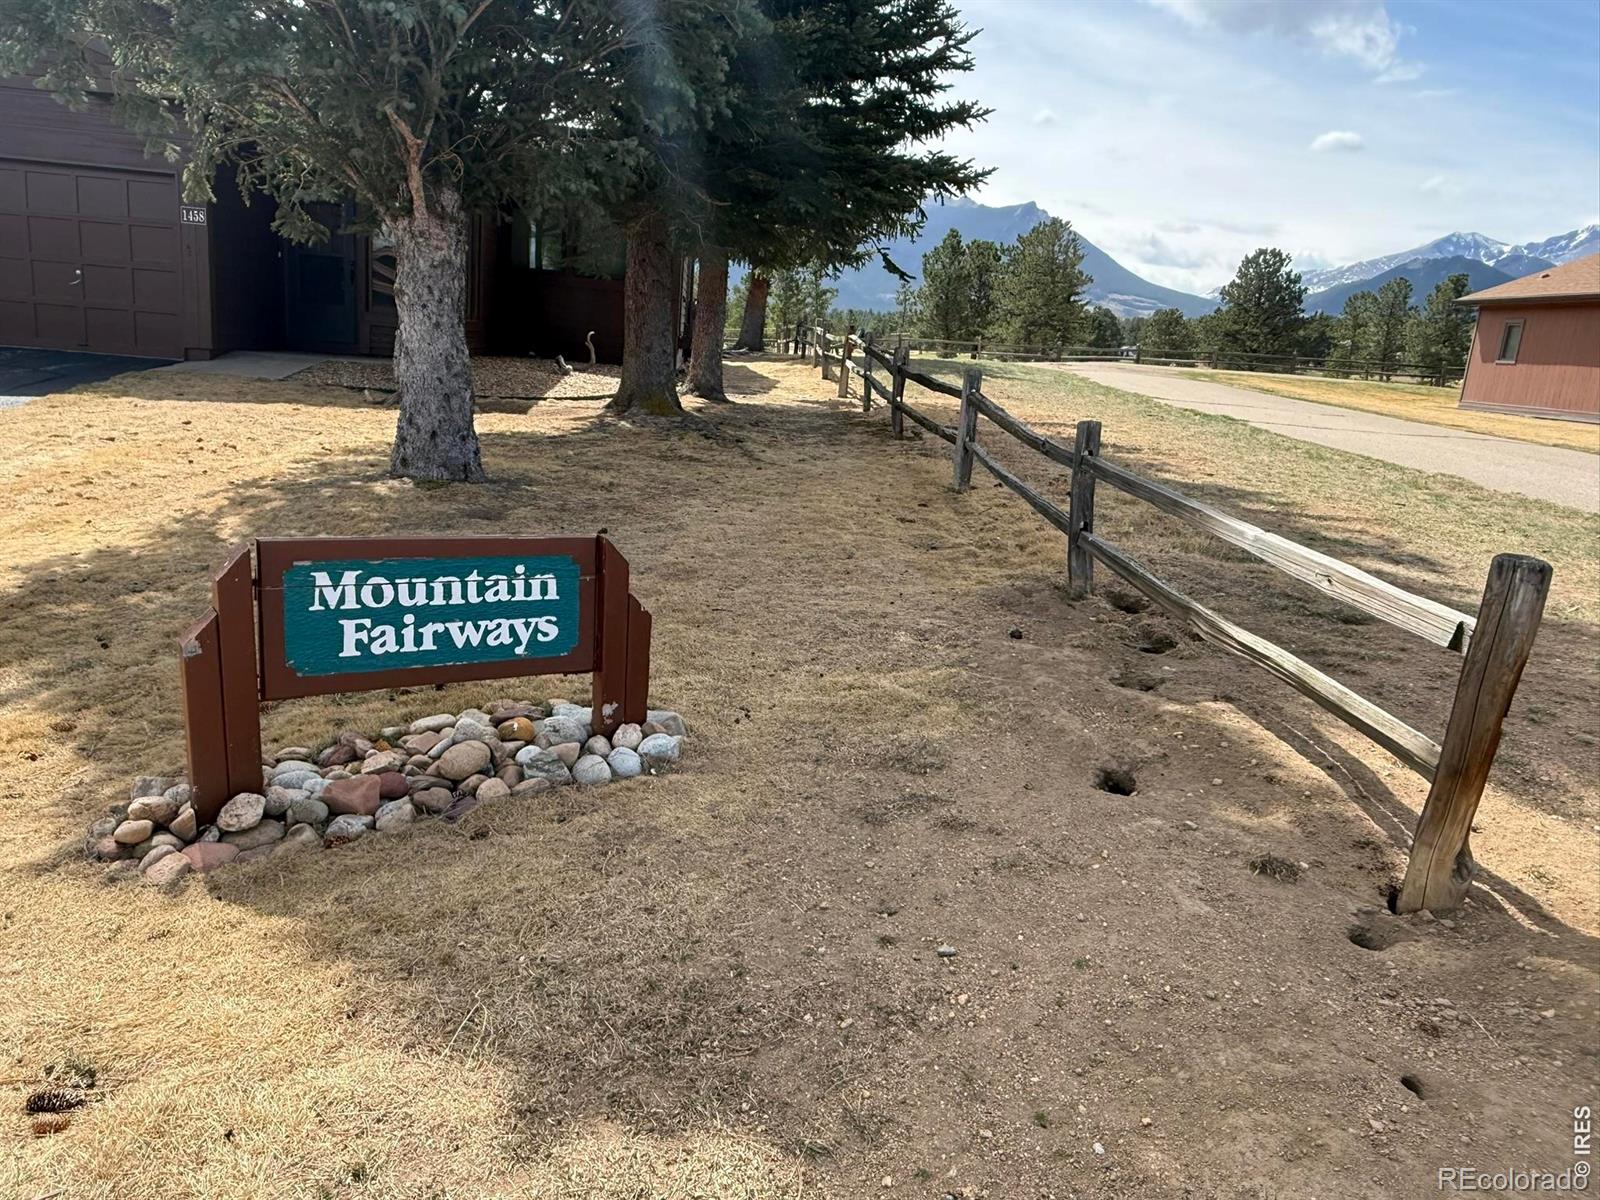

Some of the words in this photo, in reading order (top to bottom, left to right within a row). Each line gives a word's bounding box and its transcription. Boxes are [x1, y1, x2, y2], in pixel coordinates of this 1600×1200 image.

[182, 209, 205, 223] 1458
[308, 564, 560, 611] Mountain
[338, 613, 559, 657] Fairways
